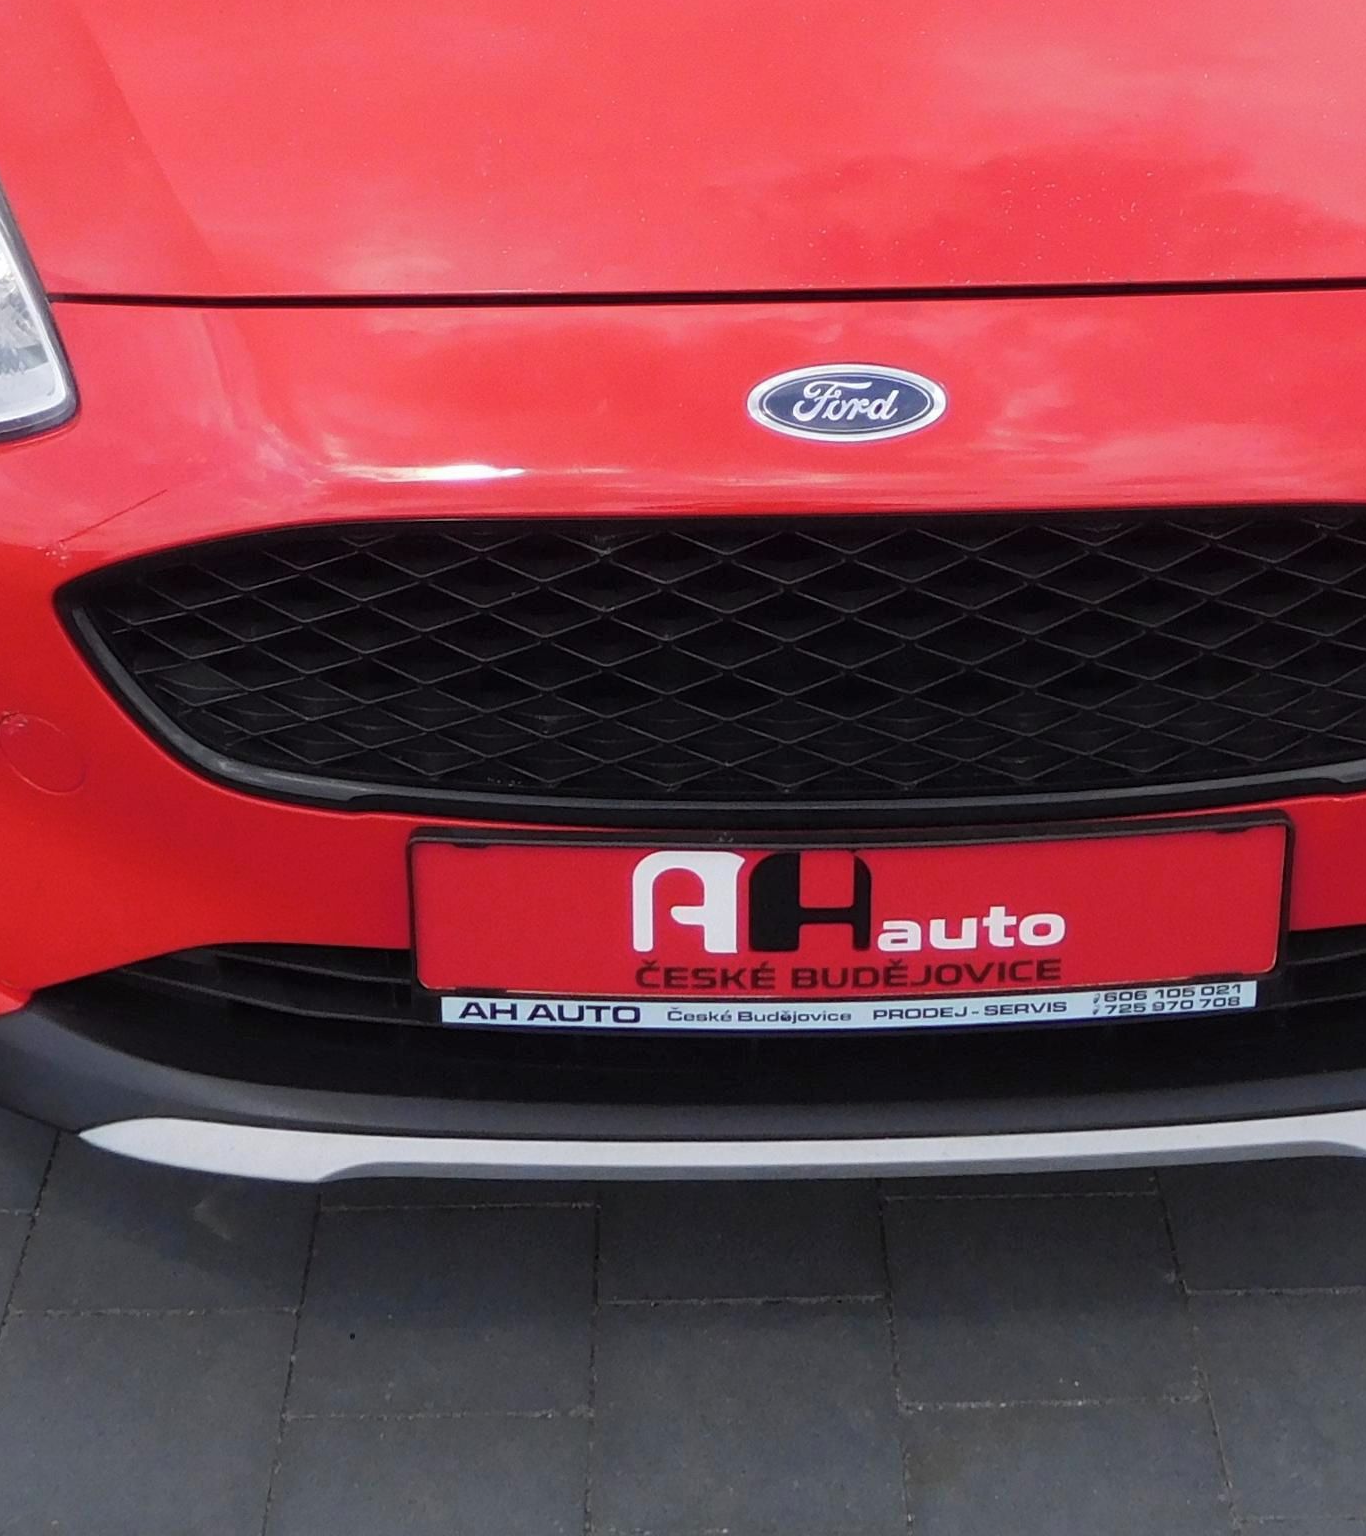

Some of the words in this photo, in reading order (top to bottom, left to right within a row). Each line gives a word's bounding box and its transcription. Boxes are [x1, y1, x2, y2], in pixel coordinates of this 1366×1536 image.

[793, 381, 899, 422] Ford
[636, 960, 775, 990] ČESKÉ
[791, 958, 1062, 989] BUDĚJOVICE
[1104, 991, 1148, 1003] 606
[1155, 987, 1196, 999] 105
[1201, 984, 1241, 996] 021
[459, 1002, 517, 1020] AH
[527, 1004, 641, 1023] AUTO
[667, 1007, 732, 1022] České
[738, 1009, 852, 1024] Budějovice
[873, 1006, 967, 1020] PRODEJ
[984, 1001, 1068, 1016] SERVIS
[1105, 1002, 1146, 1014] 725
[1152, 999, 1193, 1012] 970
[1199, 997, 1240, 1009] 708
